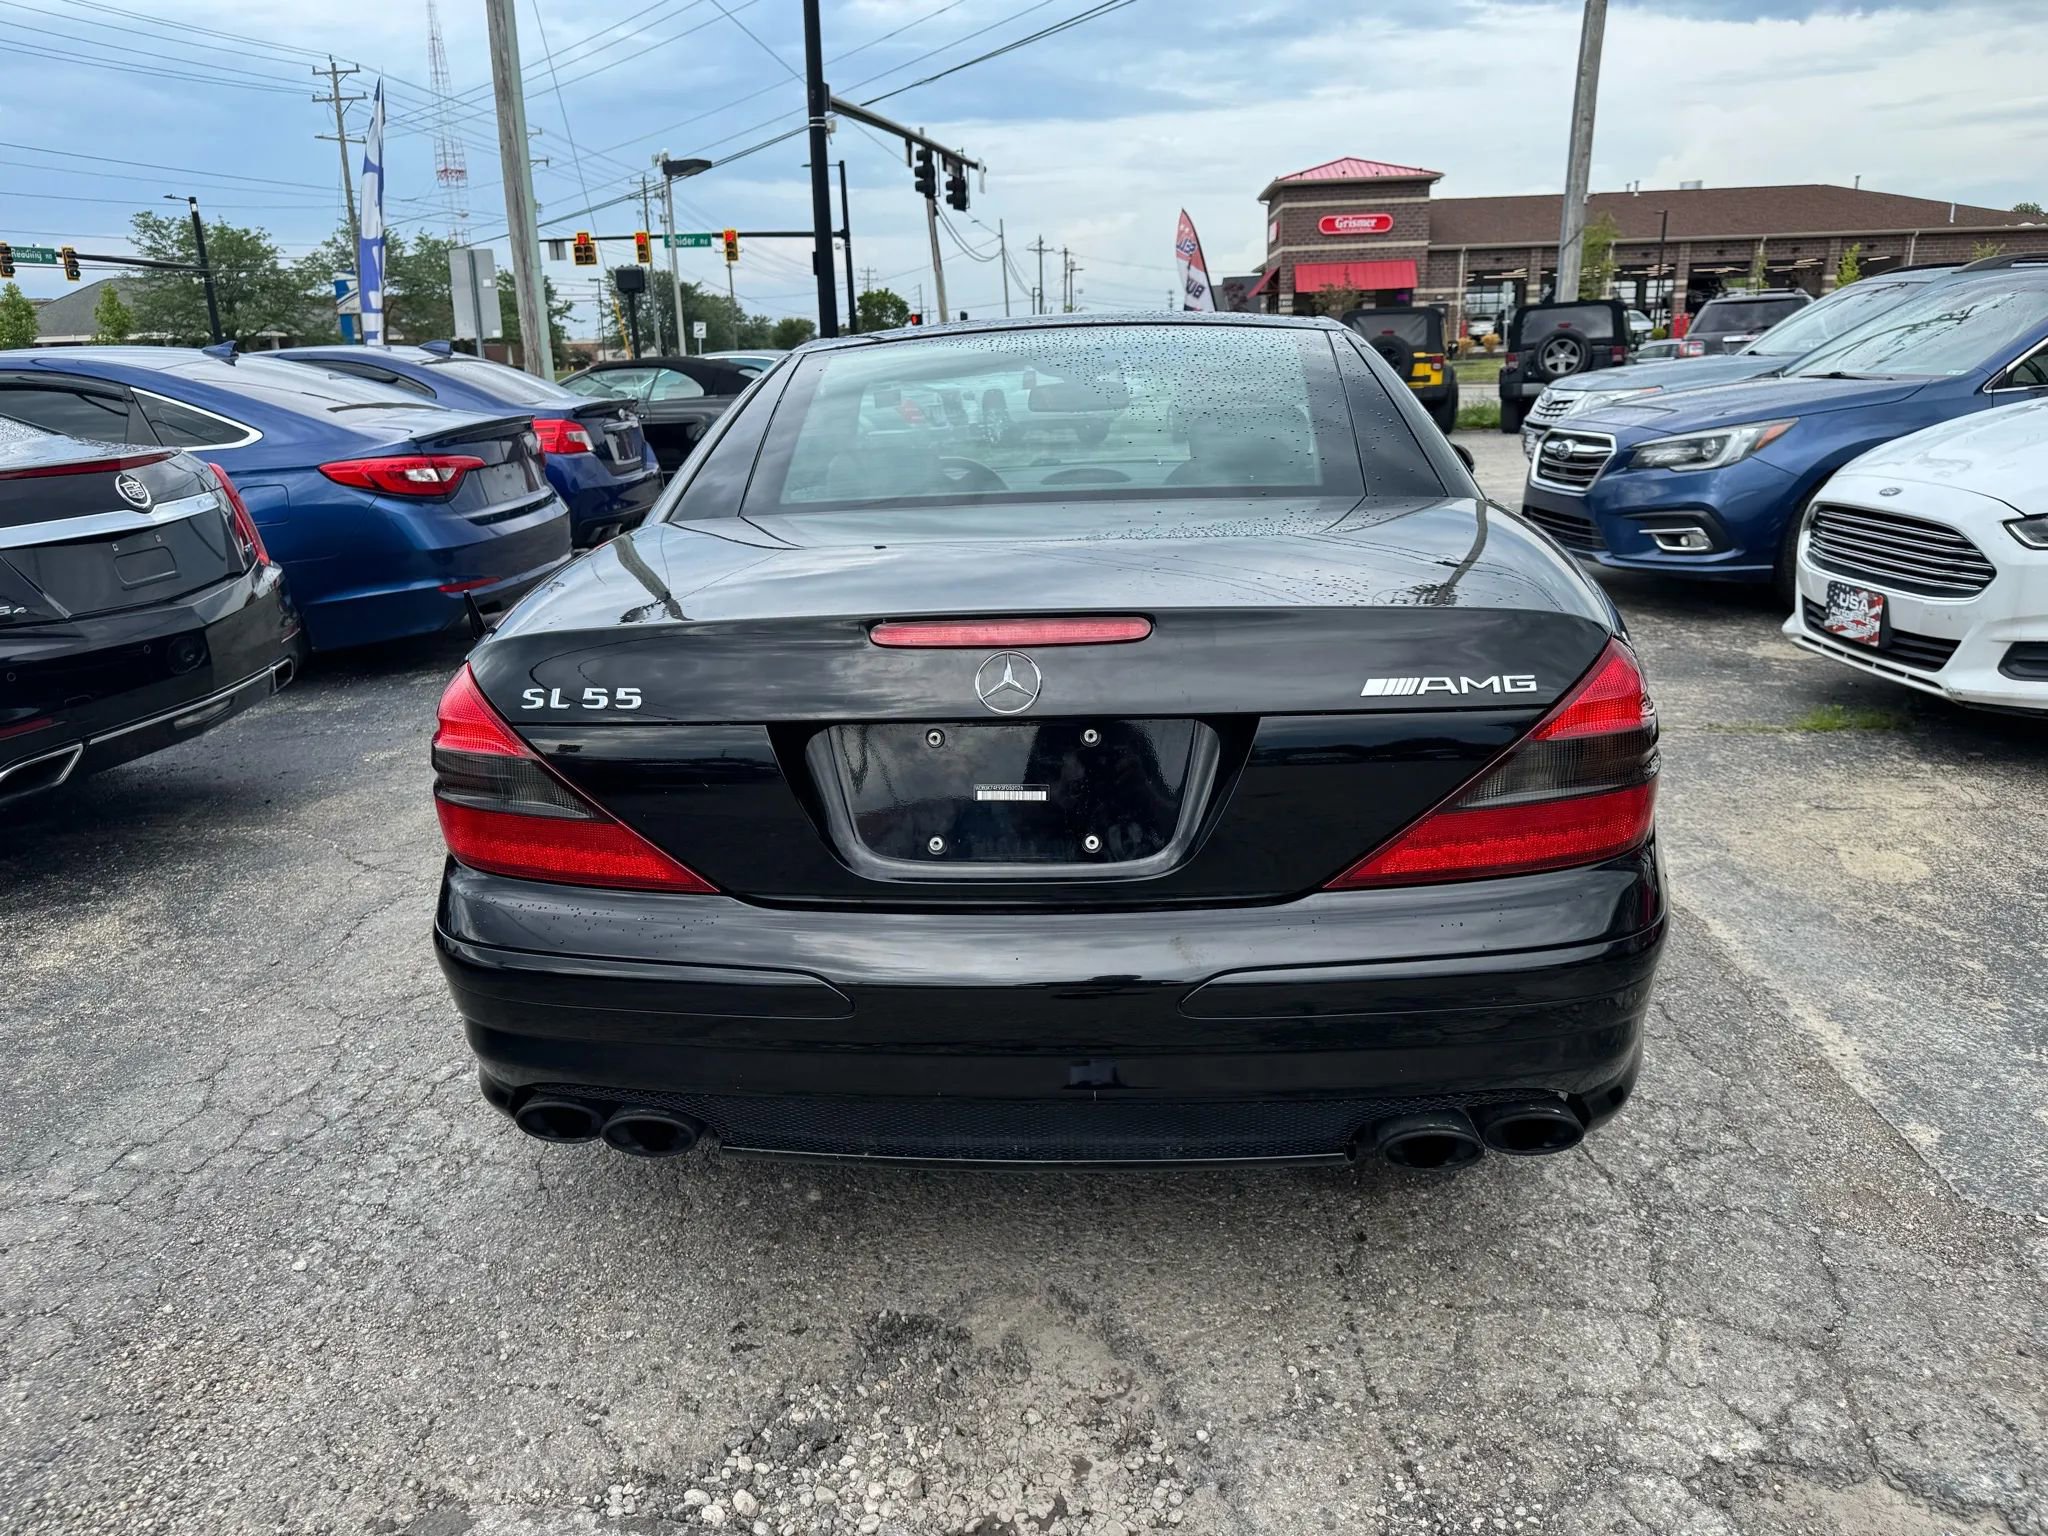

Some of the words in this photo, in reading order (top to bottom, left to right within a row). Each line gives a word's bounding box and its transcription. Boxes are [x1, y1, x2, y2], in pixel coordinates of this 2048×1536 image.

[1334, 216, 1378, 229] Grismer
[1839, 591, 1869, 614] USA
[1416, 674, 1538, 695] AMG
[521, 688, 571, 710] SL
[582, 687, 642, 710] 55
